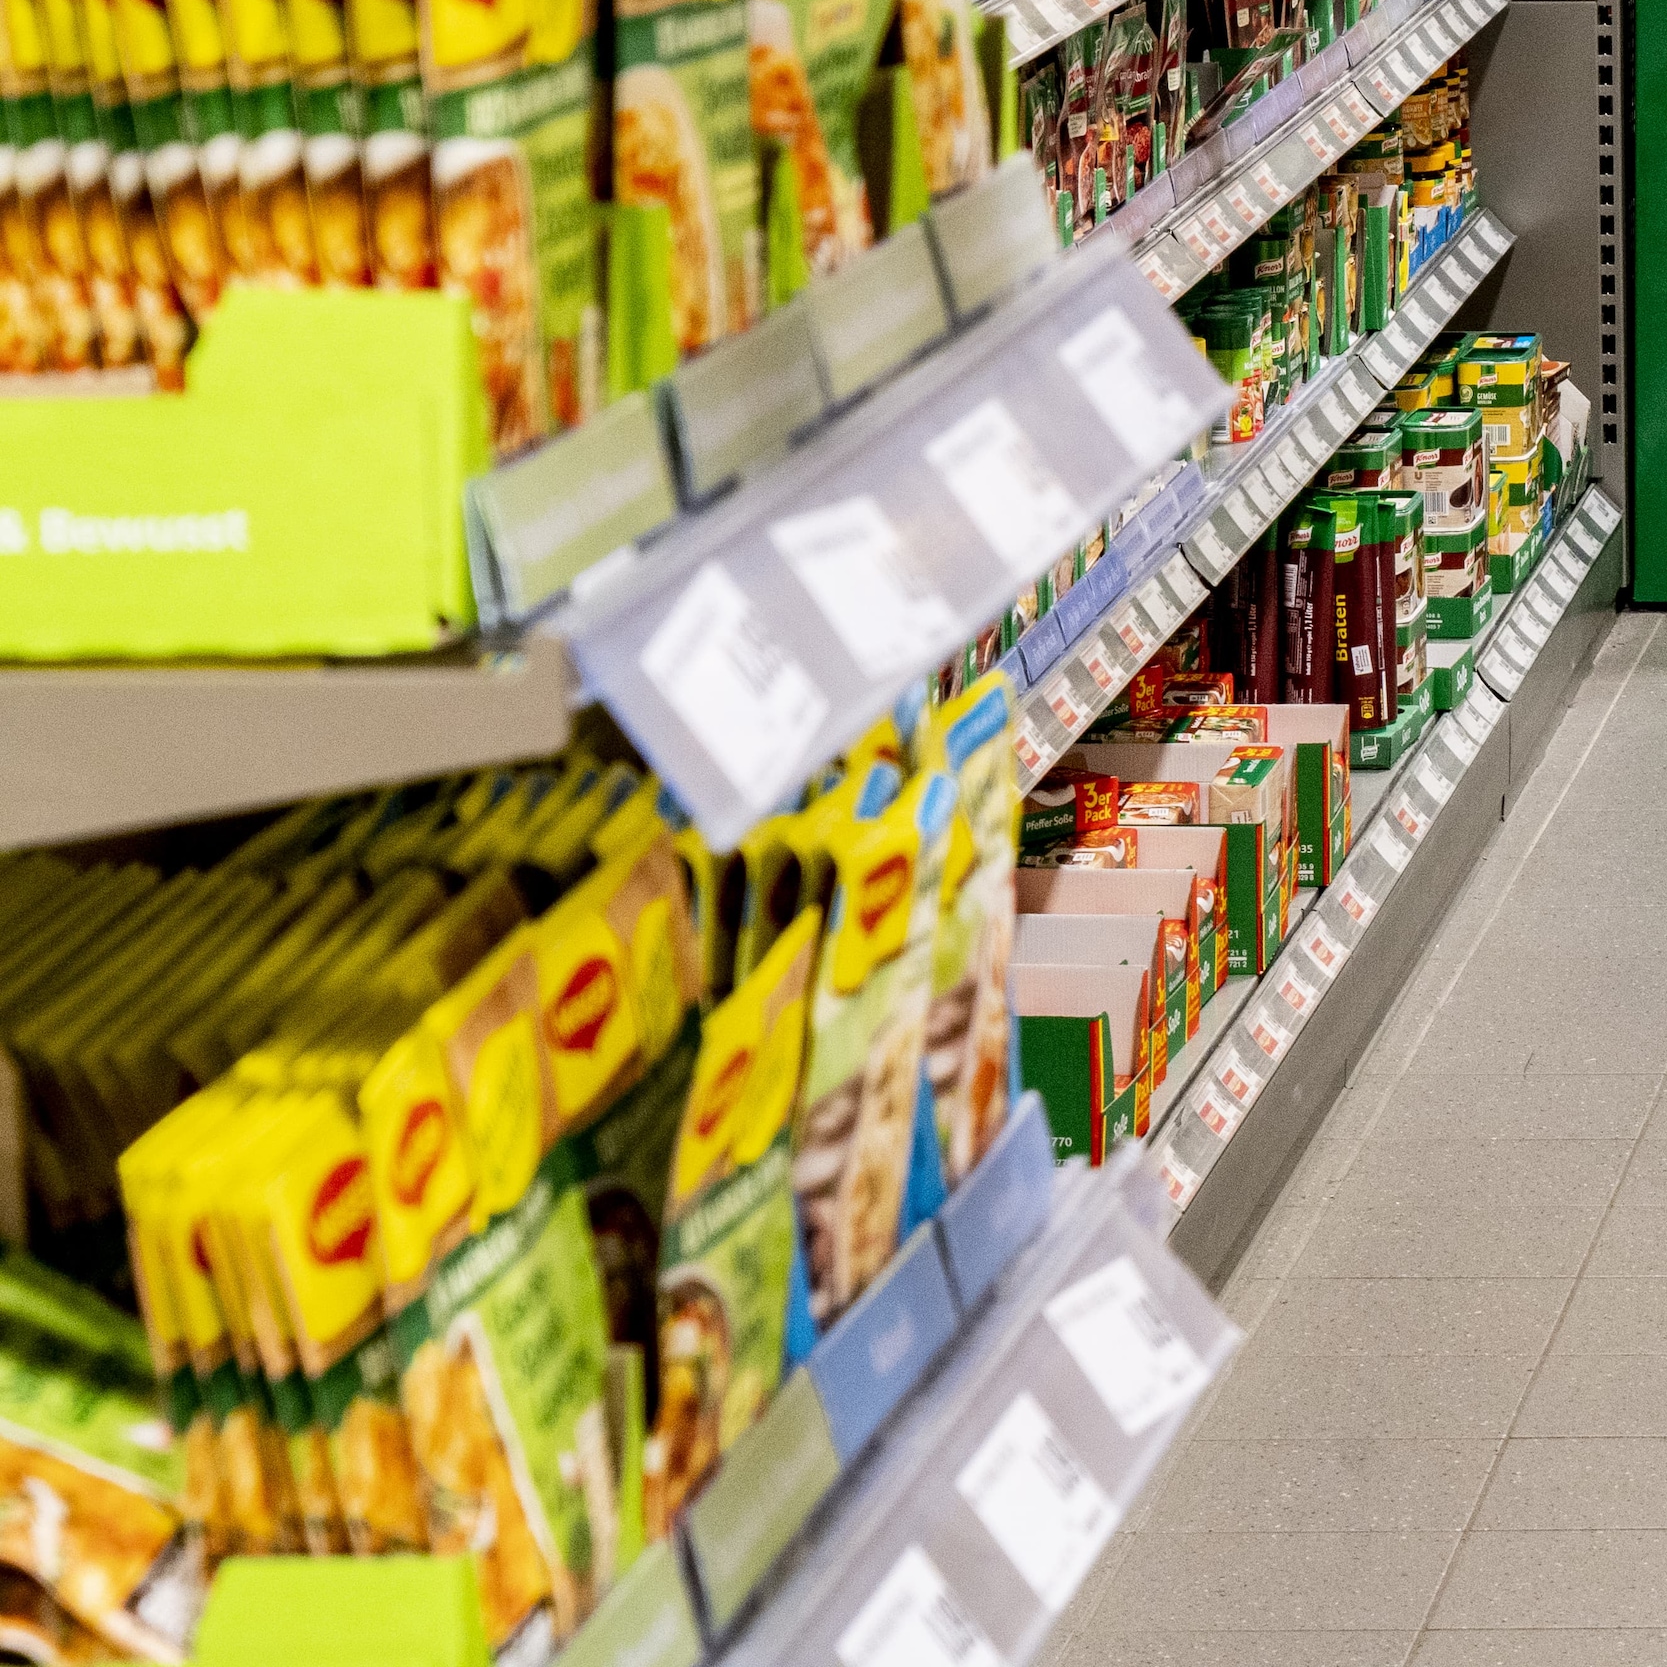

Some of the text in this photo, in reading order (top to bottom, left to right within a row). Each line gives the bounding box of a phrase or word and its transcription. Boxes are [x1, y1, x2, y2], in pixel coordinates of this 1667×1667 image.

[1335, 594, 1349, 660] Braten
[1137, 675, 1159, 695] 3er
[1136, 692, 1158, 711] Pack
[1084, 787, 1113, 811] 3er
[1025, 814, 1073, 831] Pfeffer Soße
[1084, 806, 1113, 829] Pack
